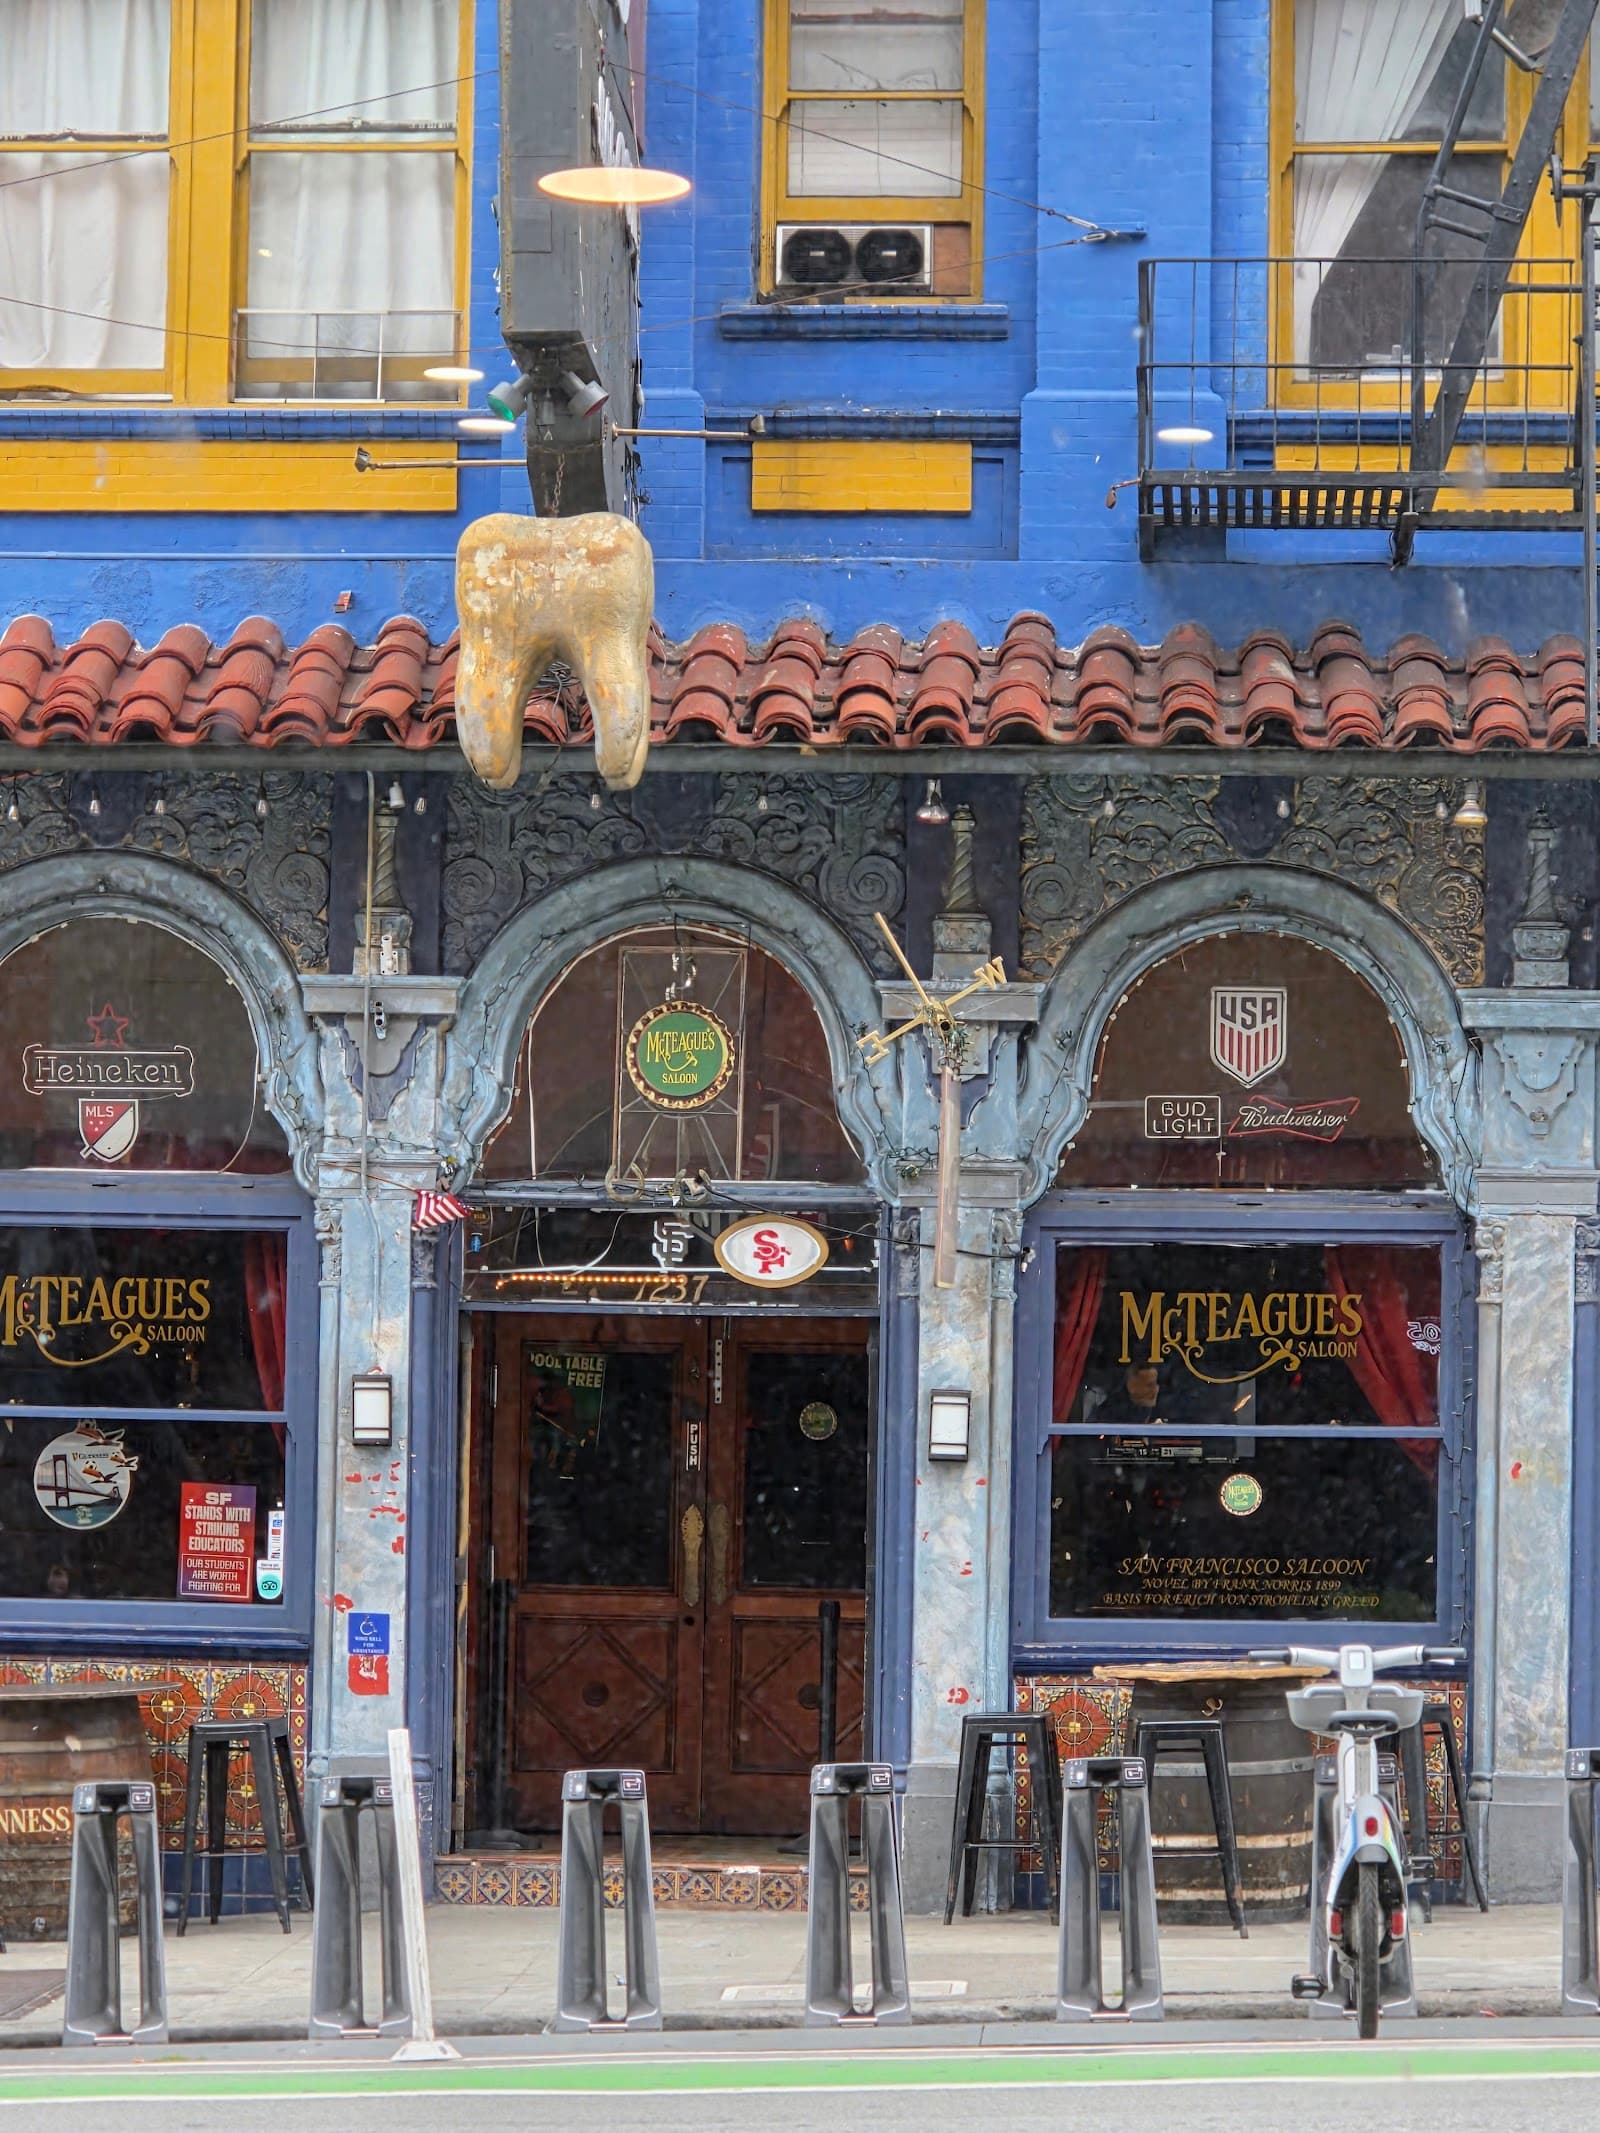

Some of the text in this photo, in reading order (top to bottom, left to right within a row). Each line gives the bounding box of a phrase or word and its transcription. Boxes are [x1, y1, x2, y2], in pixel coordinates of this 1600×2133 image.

[1220, 997, 1278, 1031] USA
[35, 1056, 183, 1083] Heineken
[662, 1073, 698, 1084] SALOON
[85, 1105, 114, 1118] MLS
[1161, 1102, 1206, 1117] BUD
[1238, 1105, 1349, 1128] Budweiser
[1153, 1118, 1215, 1134] LIGHT
[634, 1274, 709, 1304] 1237
[147, 1325, 206, 1343] SALOON
[1298, 1341, 1358, 1358] SALOON
[565, 1353, 604, 1371] TABLE
[568, 1372, 602, 1388] FREE
[689, 1424, 698, 1466] PUSH
[205, 1492, 232, 1505] SF
[185, 1505, 251, 1522] STANDS WITH
[195, 1521, 240, 1537] STRIKING
[188, 1536, 245, 1552] EDUCATORS
[187, 1558, 245, 1570] OUR STUDENTS
[1118, 1558, 1371, 1576] SAN FRANCISCO SALOON
[192, 1570, 238, 1580] ARE WORTH
[188, 1581, 241, 1592] FIGHTING FOR
[1141, 1578, 1341, 1591] NOVEL BY FRANK NORRIS 1899
[1103, 1593, 1142, 1605] BASIS
[1144, 1593, 1171, 1605] FOR
[1172, 1593, 1217, 1606] ERICH
[1332, 1594, 1380, 1608] GREED
